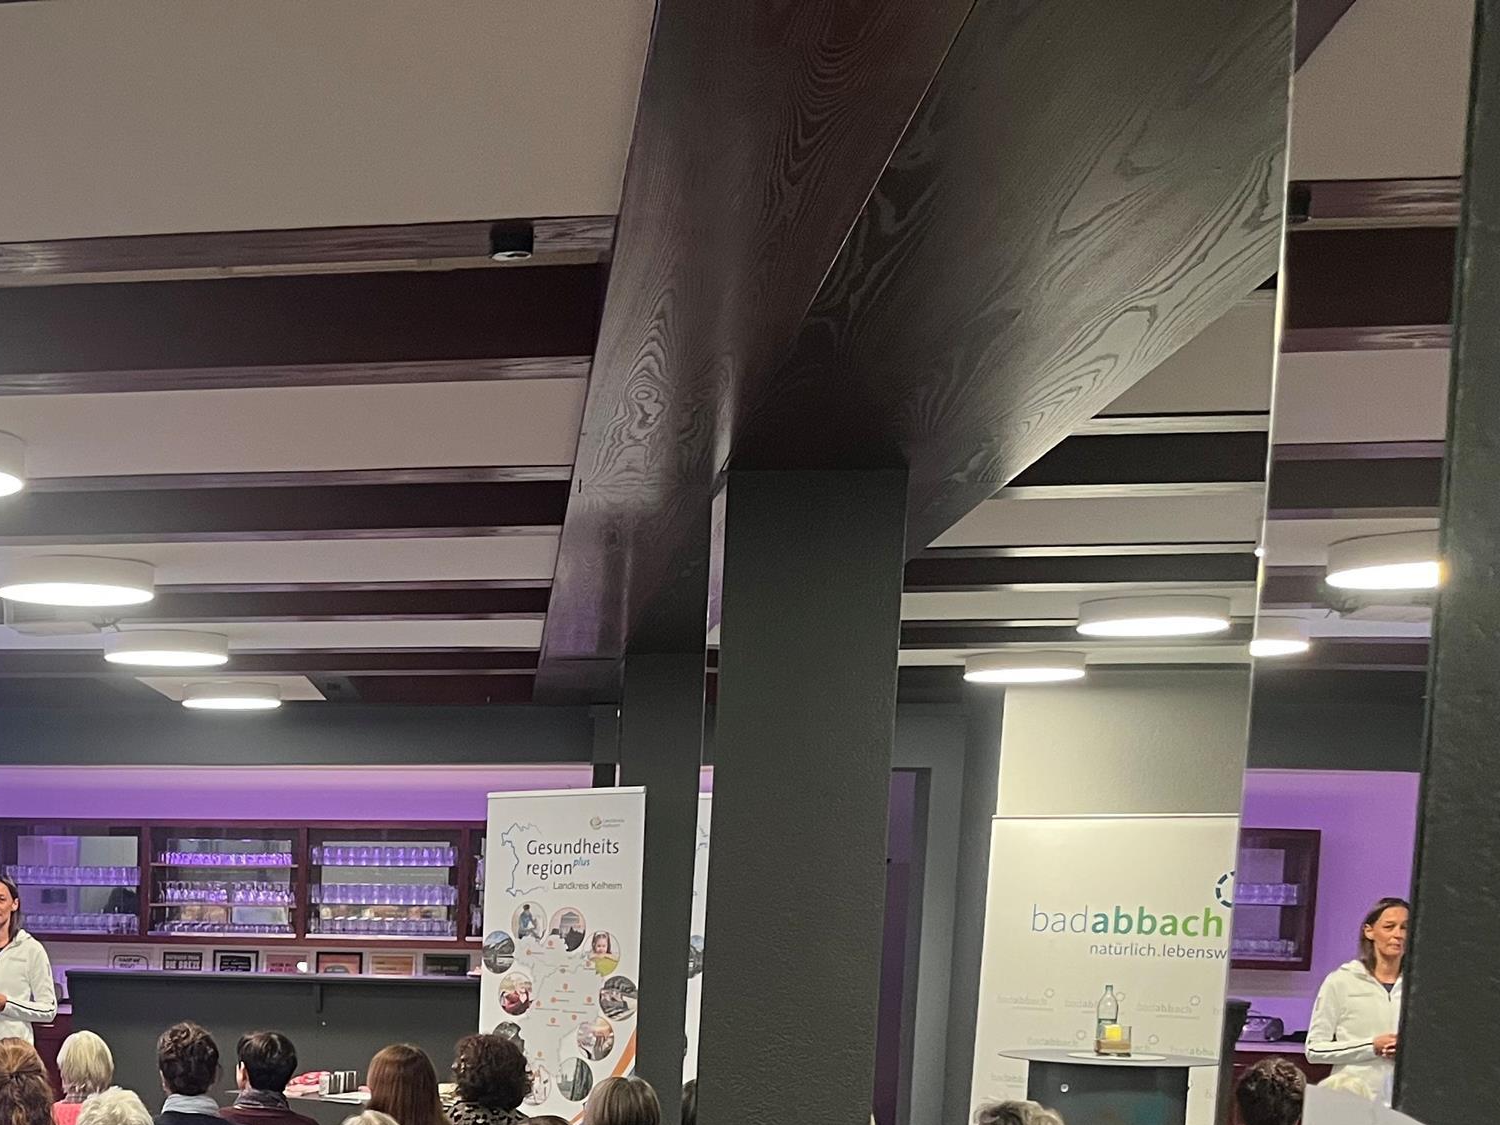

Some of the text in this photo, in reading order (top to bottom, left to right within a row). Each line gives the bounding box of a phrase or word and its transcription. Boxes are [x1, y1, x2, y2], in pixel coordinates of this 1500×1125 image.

[526, 838, 619, 855] Gesundheits
[553, 881, 622, 890] Landkreis Kelheim
[1031, 903, 1223, 937] badabbach
